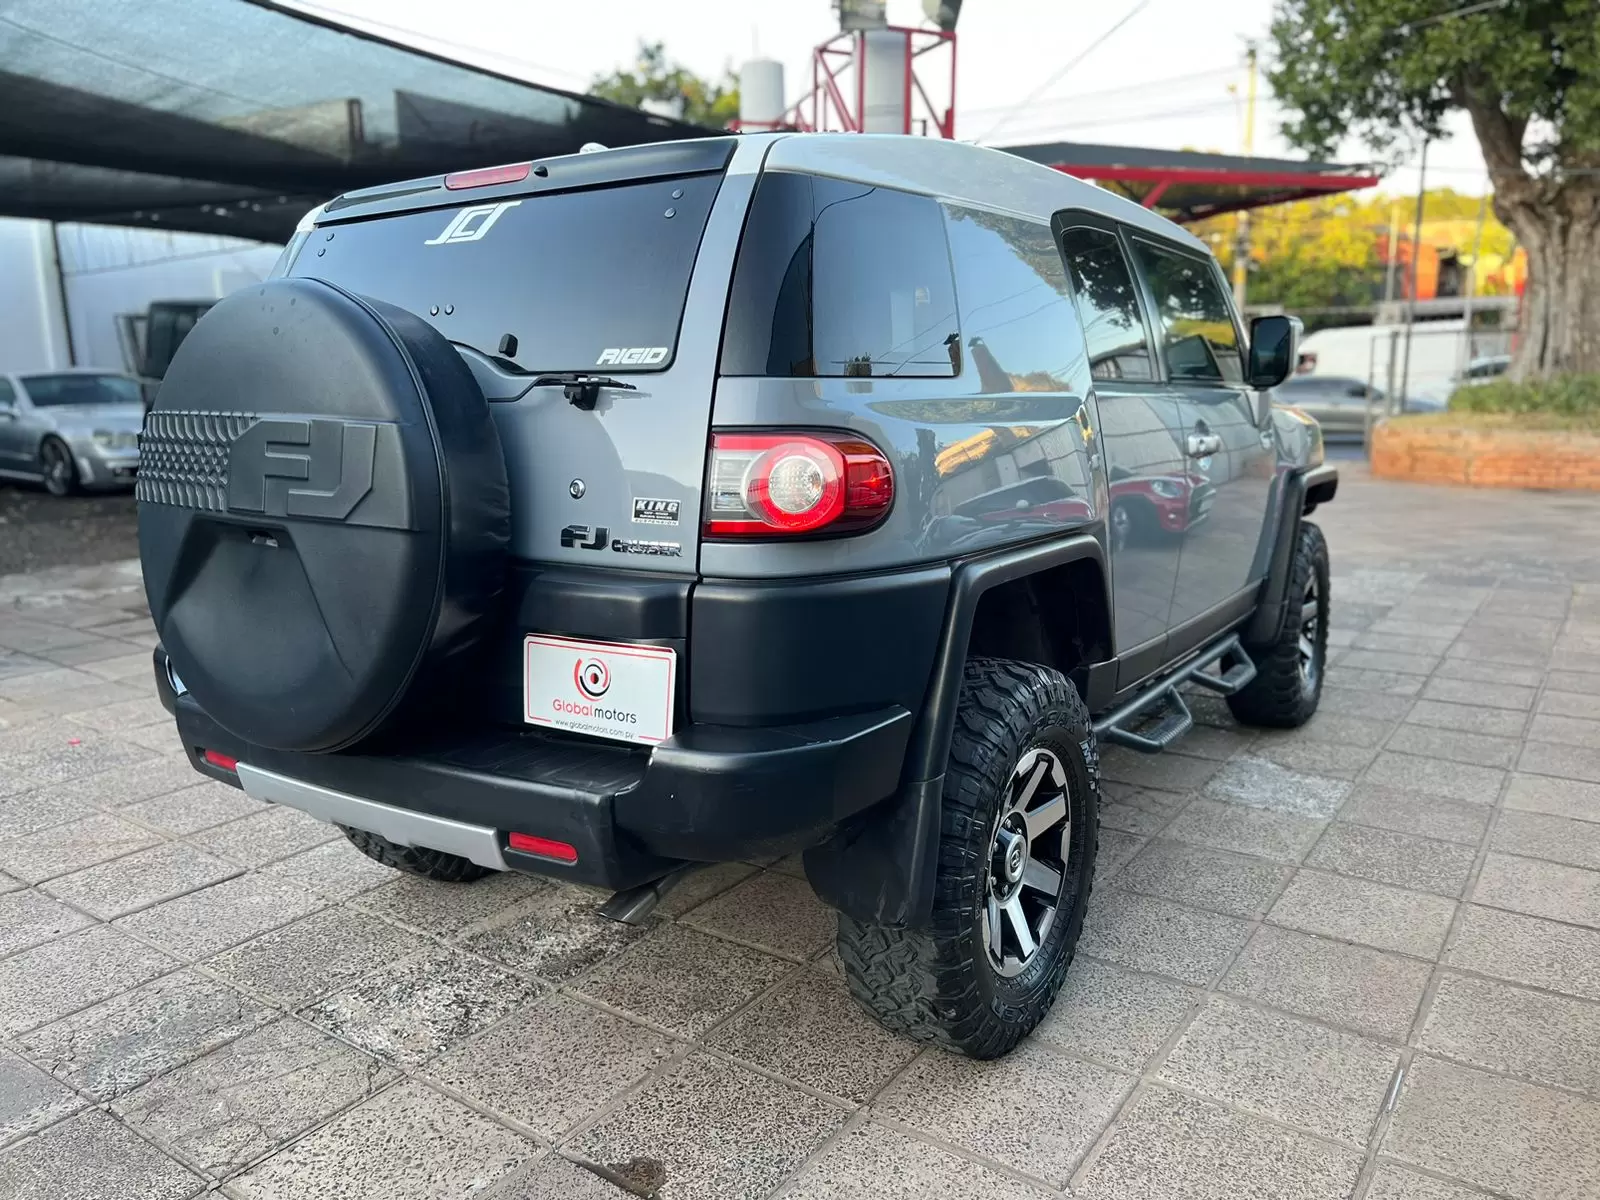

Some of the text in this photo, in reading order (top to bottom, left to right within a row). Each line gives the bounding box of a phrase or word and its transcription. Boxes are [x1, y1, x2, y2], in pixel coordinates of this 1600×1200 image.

[596, 347, 669, 365] RIGID
[229, 418, 378, 521] FJ
[636, 500, 678, 513] KING
[560, 524, 610, 551] FJ
